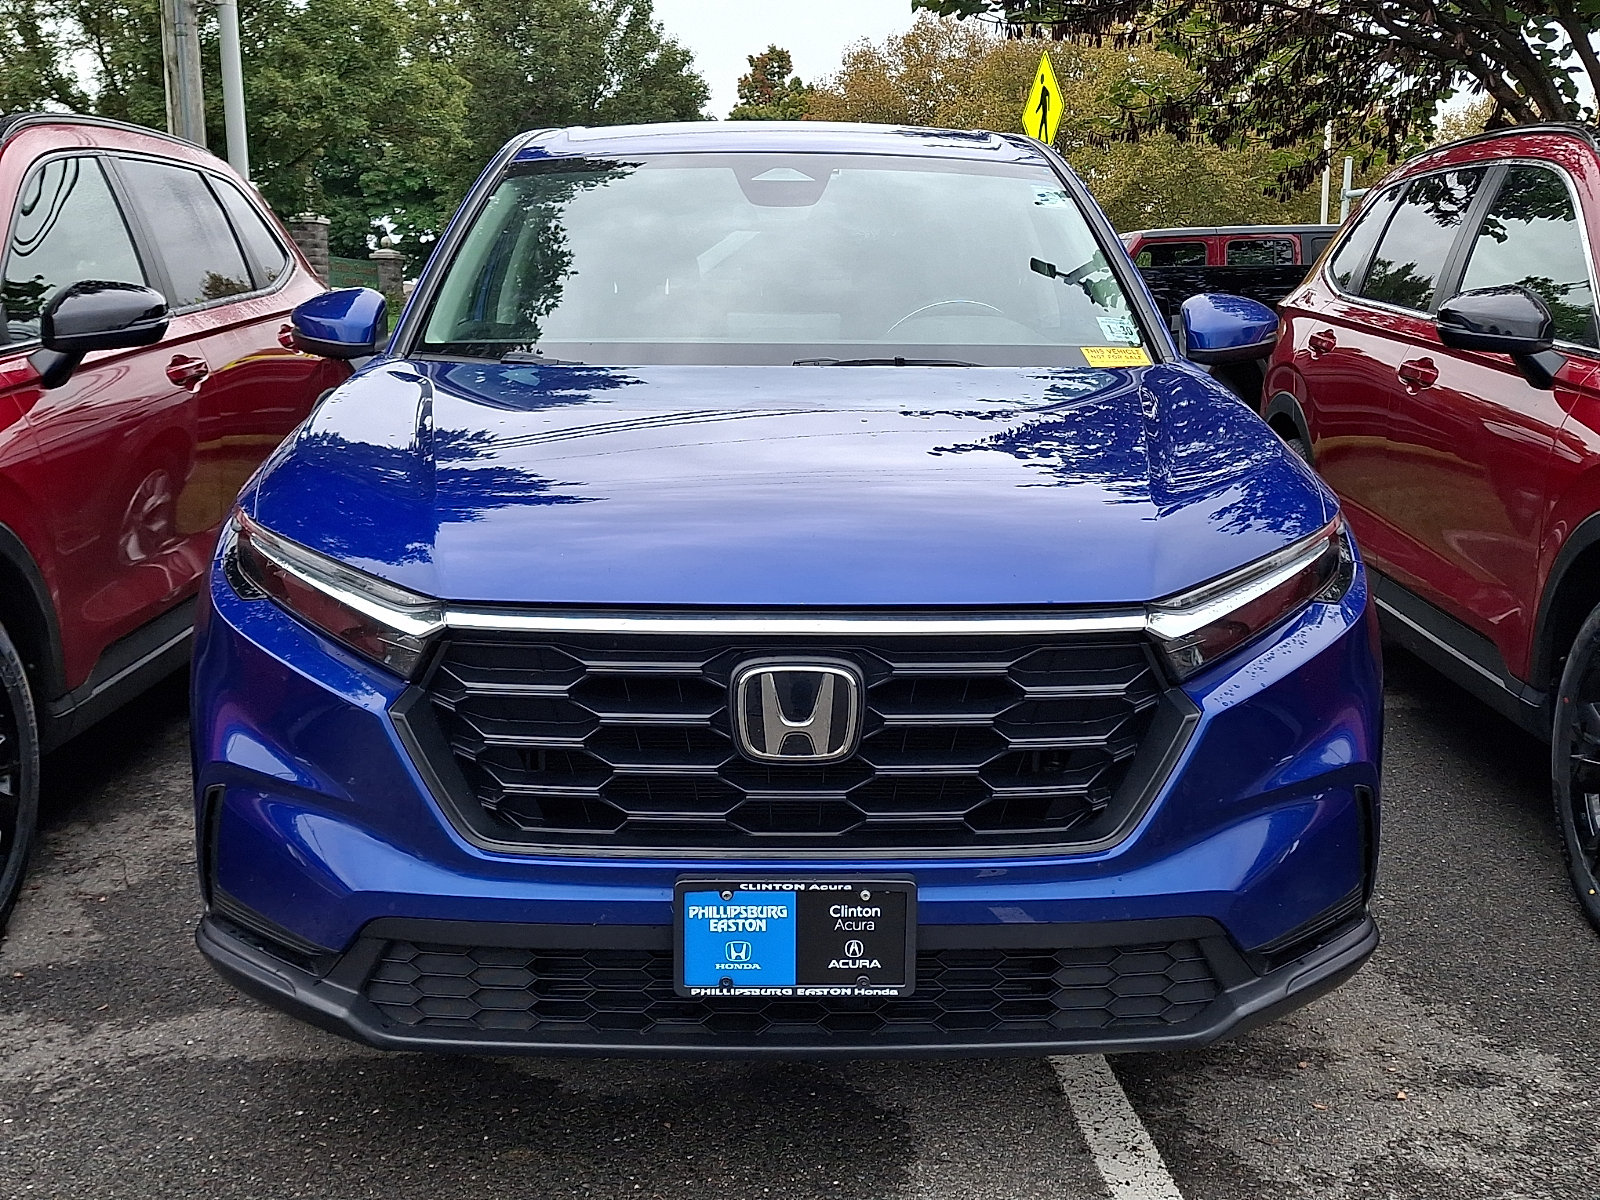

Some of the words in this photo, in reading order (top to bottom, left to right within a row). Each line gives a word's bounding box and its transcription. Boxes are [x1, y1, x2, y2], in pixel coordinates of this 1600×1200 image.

[689, 906, 788, 919] PHILLIPSBURG
[830, 905, 880, 918] Clinton
[709, 919, 766, 933] EASTON
[834, 920, 874, 931] Acura
[828, 960, 881, 969] ACURA
[691, 988, 792, 996] PHILLIPSBURG
